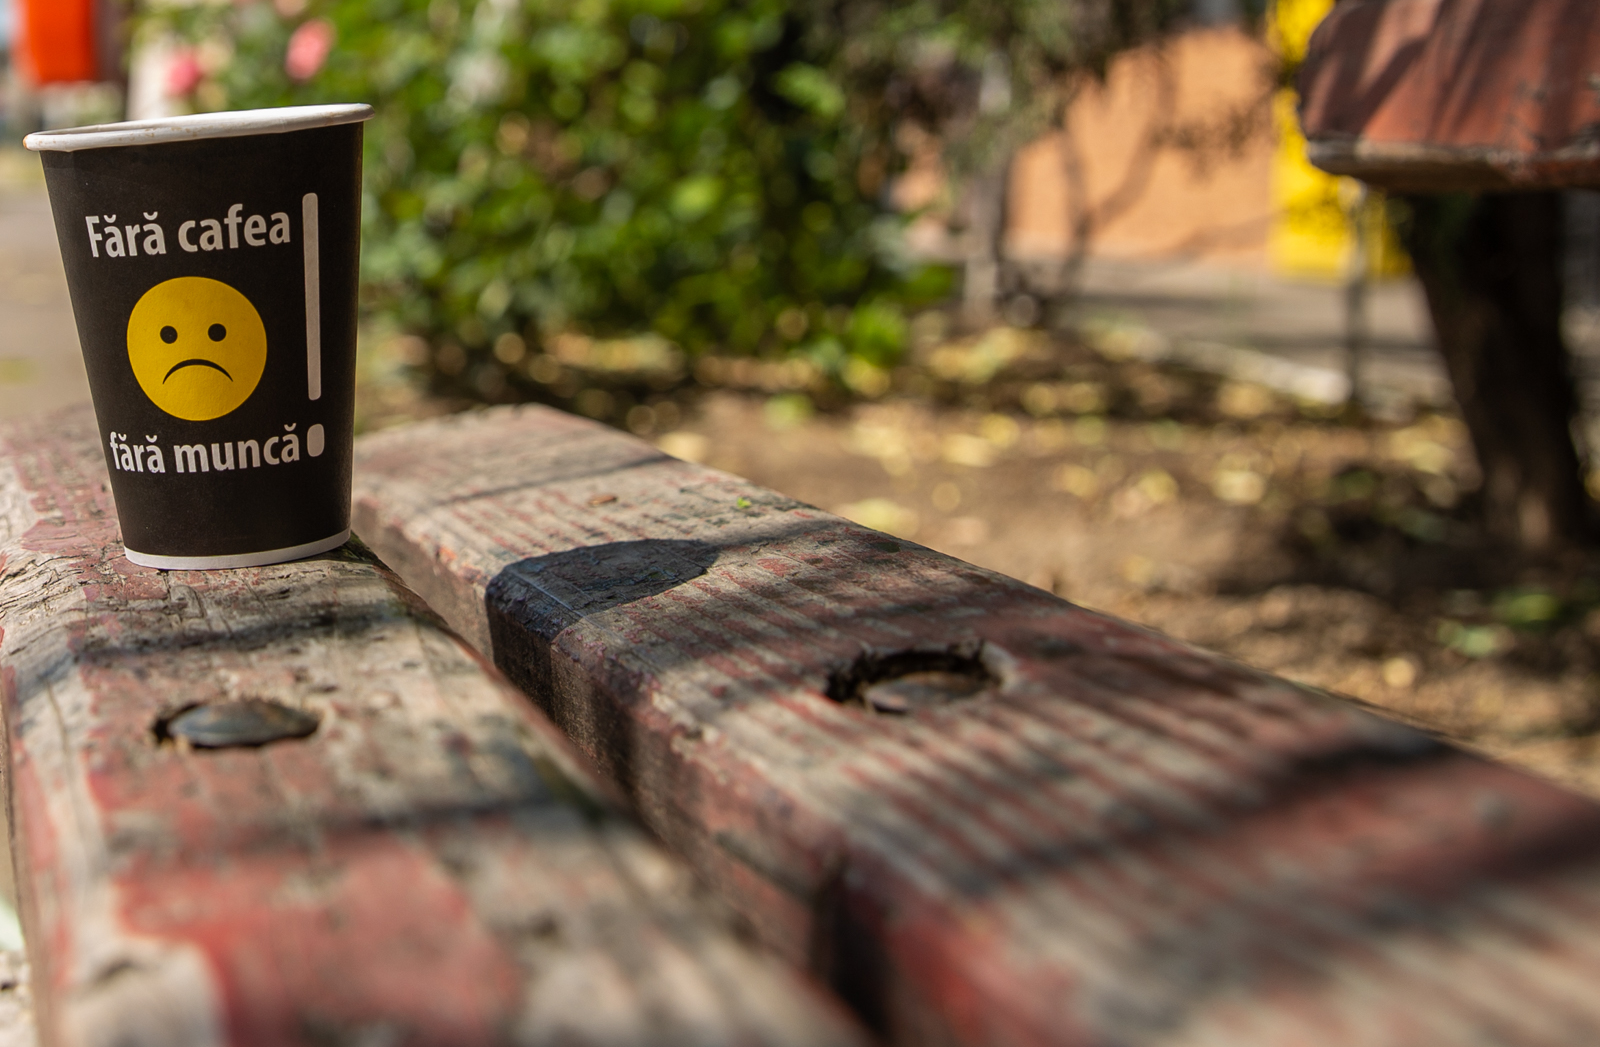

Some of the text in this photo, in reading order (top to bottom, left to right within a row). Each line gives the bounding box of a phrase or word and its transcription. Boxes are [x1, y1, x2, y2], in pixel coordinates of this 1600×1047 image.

[85, 204, 291, 258] Fără cafea
[109, 423, 300, 473] fără muncă
